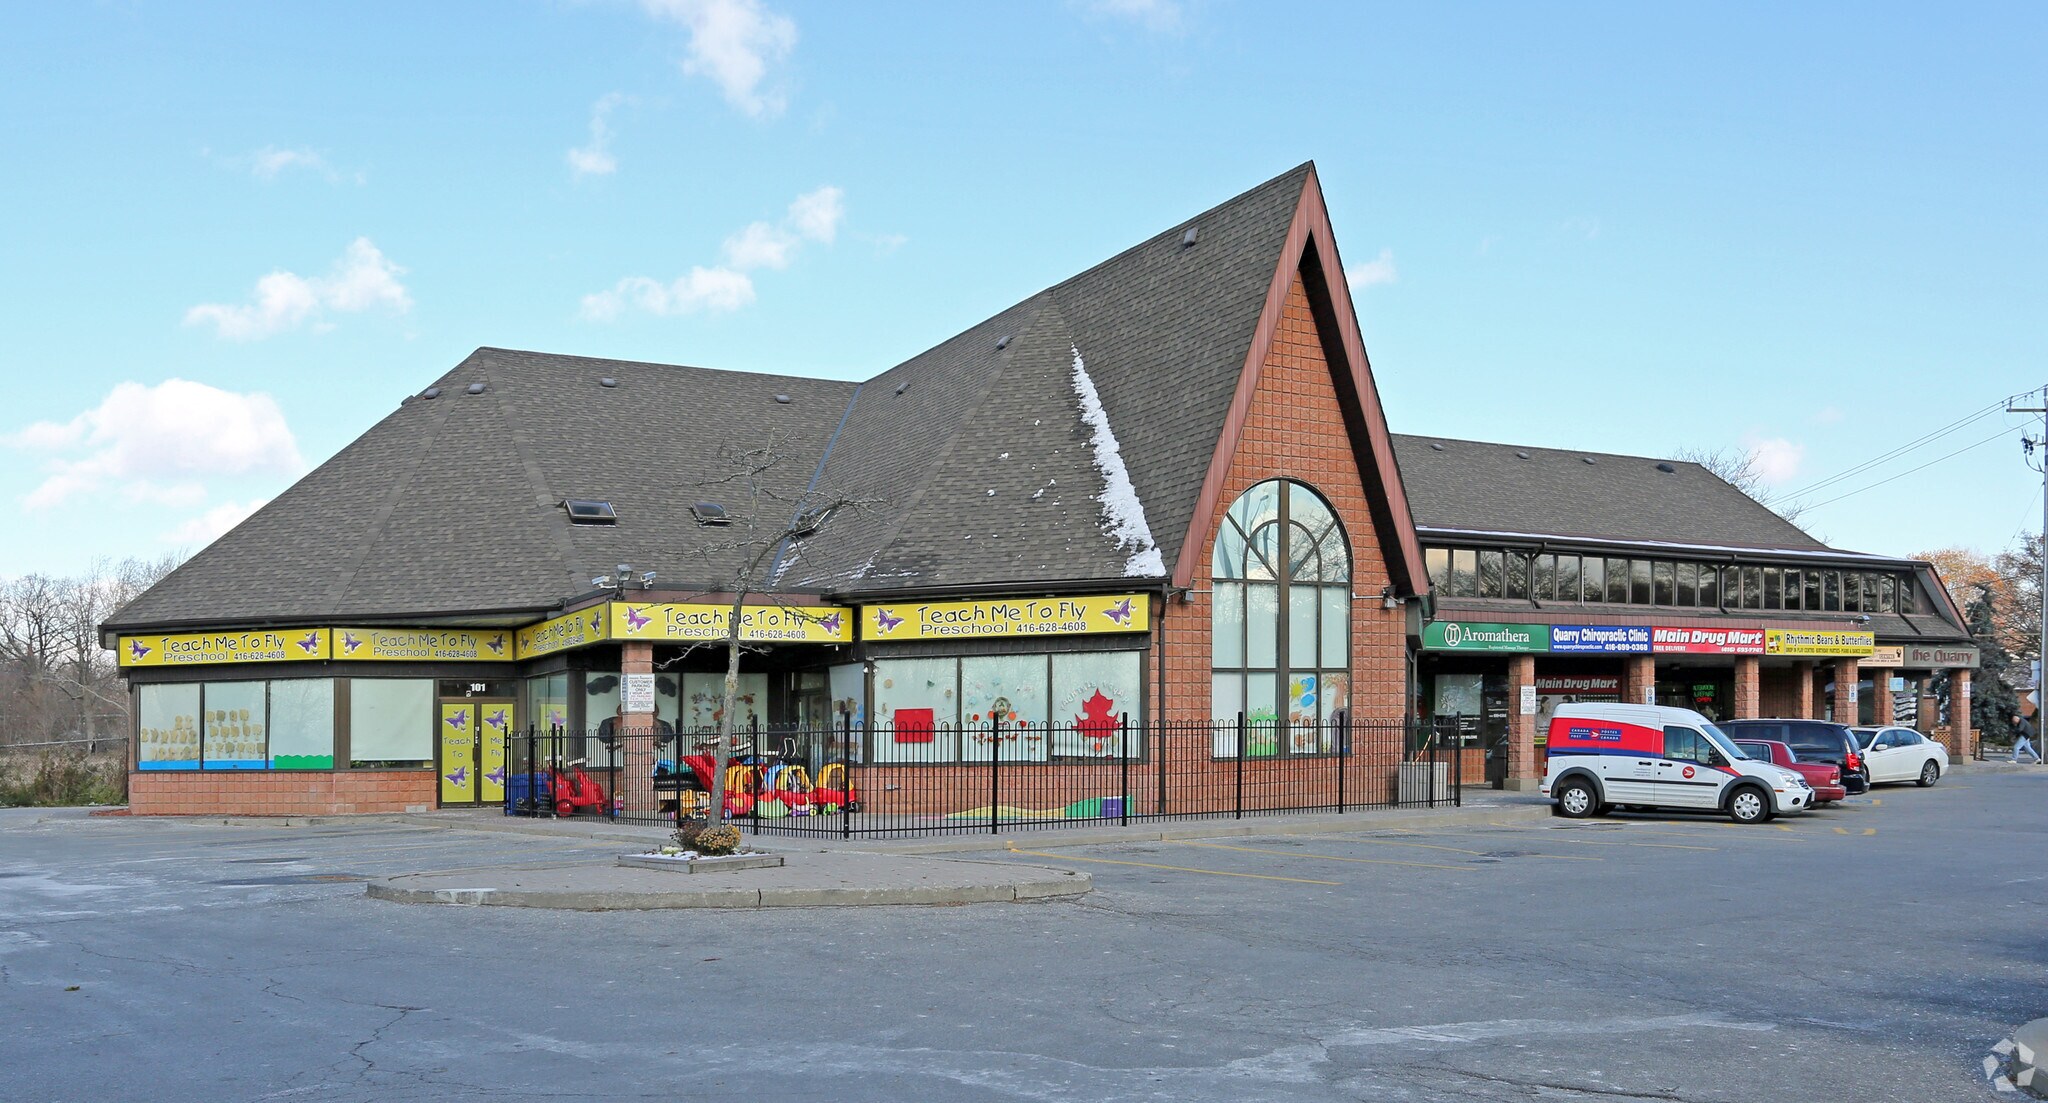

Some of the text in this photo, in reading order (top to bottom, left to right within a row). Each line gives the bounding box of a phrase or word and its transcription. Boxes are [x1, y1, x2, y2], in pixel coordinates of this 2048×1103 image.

[664, 608, 723, 625] Teach
[757, 610, 779, 625] To
[784, 611, 805, 629] Fly
[918, 602, 1086, 623] Teach Me To Fly
[532, 626, 554, 643] Teach
[667, 625, 806, 639] Preschol 416-628-4608
[921, 622, 1087, 635] Preschool 416-628-4608
[1462, 627, 1530, 642] Aromathera
[1553, 627, 1649, 644] Quarry Chiropractic Clinic
[161, 634, 286, 652] Teach Me To Fly
[371, 632, 478, 649] Teach Me To Fly
[1653, 629, 1763, 646] Main Drug Mart
[1786, 633, 1872, 647] Rhythmic Bears & Butterflies
[373, 647, 478, 658] Preschool 416-628-4608
[1604, 643, 1648, 651] 416-699-0368
[164, 651, 286, 662] Preschool 416-628-4608
[1912, 648, 1973, 664] the Quarry
[470, 683, 486, 692] 101
[1535, 678, 1618, 690] Main Drug Mart
[443, 737, 471, 745] Teach
[490, 737, 503, 745] Me
